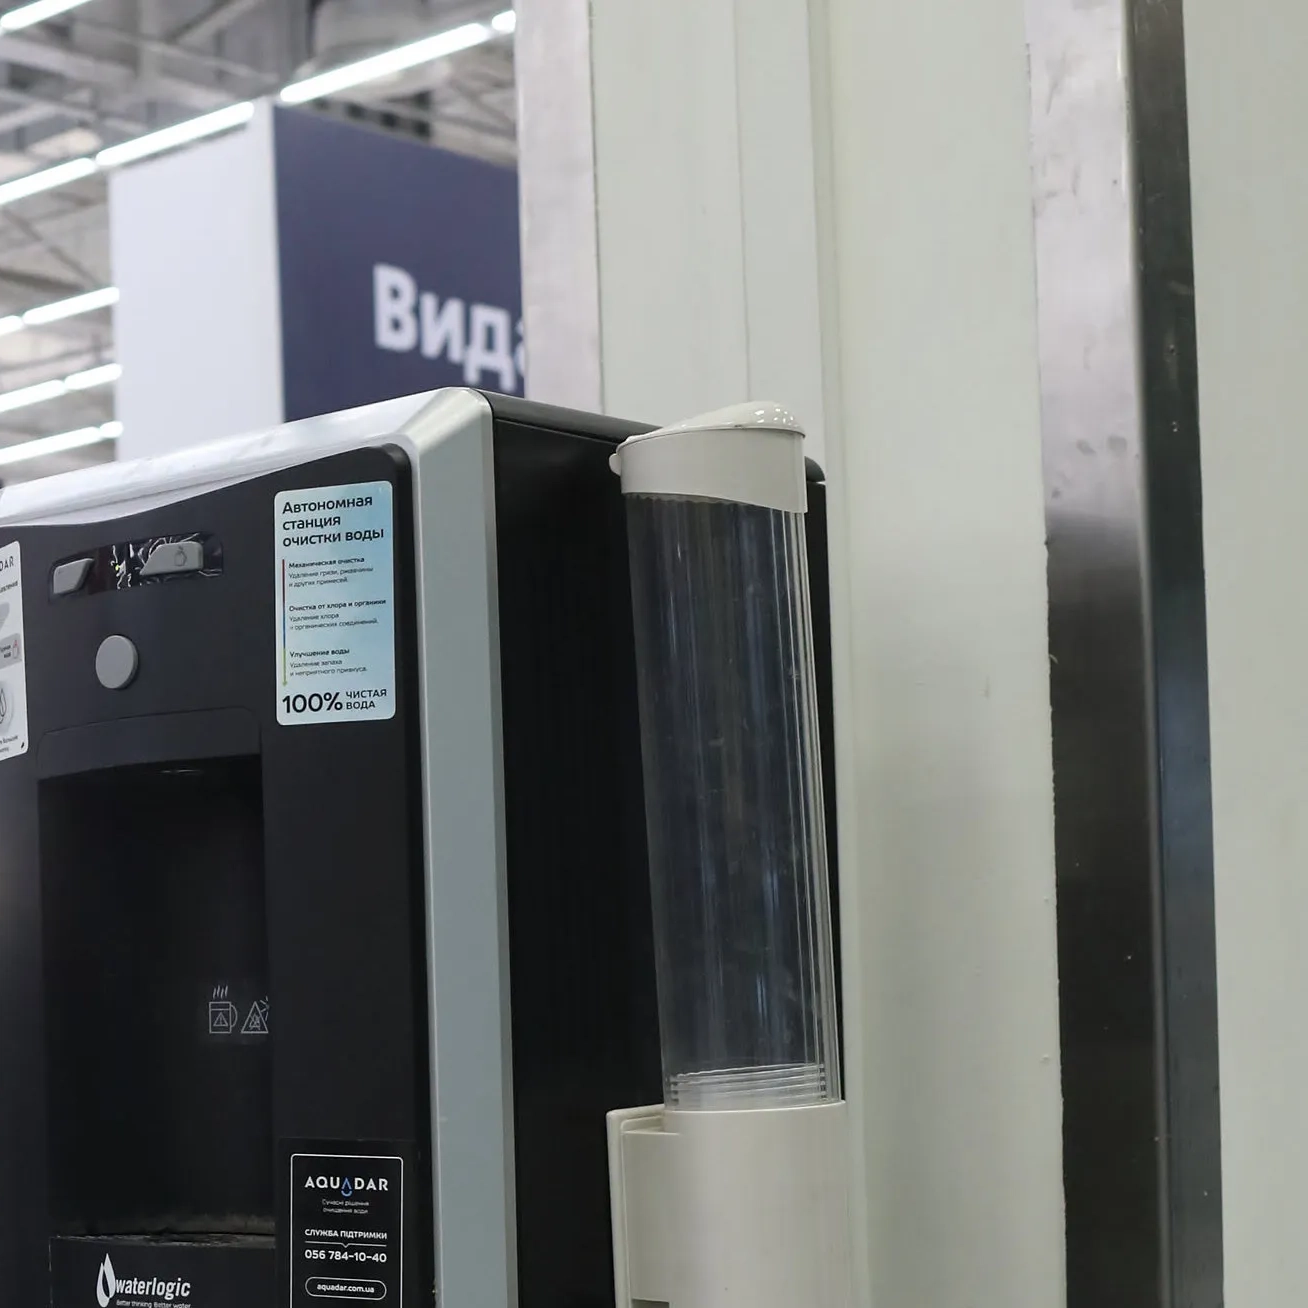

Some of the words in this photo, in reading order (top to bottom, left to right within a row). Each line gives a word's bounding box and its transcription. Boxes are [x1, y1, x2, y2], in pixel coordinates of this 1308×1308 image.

[372, 263, 526, 392] Вид
[282, 496, 373, 514] Автономная
[282, 516, 341, 530] станция
[282, 533, 341, 547] очистки
[345, 529, 384, 541] воды
[288, 560, 337, 568] Механическая
[337, 557, 365, 565] очистка
[289, 604, 317, 612] Очистка
[326, 601, 347, 610] хлора
[353, 600, 386, 608] органики
[289, 649, 330, 659] Улучшение
[330, 648, 350, 656] воды
[282, 692, 343, 713] 100%
[345, 689, 387, 699] ЧИСТАЯ
[346, 701, 376, 710] ВОДА
[304, 1175, 389, 1197] AQUADAR
[304, 1228, 339, 1238] СЛУЖБА
[340, 1230, 387, 1240] ПІДТРИМКИ
[304, 1249, 326, 1260] 056
[328, 1250, 387, 1262] 784-10-40
[116, 1277, 191, 1300] waterlogic
[317, 1284, 375, 1293] aquadar.com.ua
